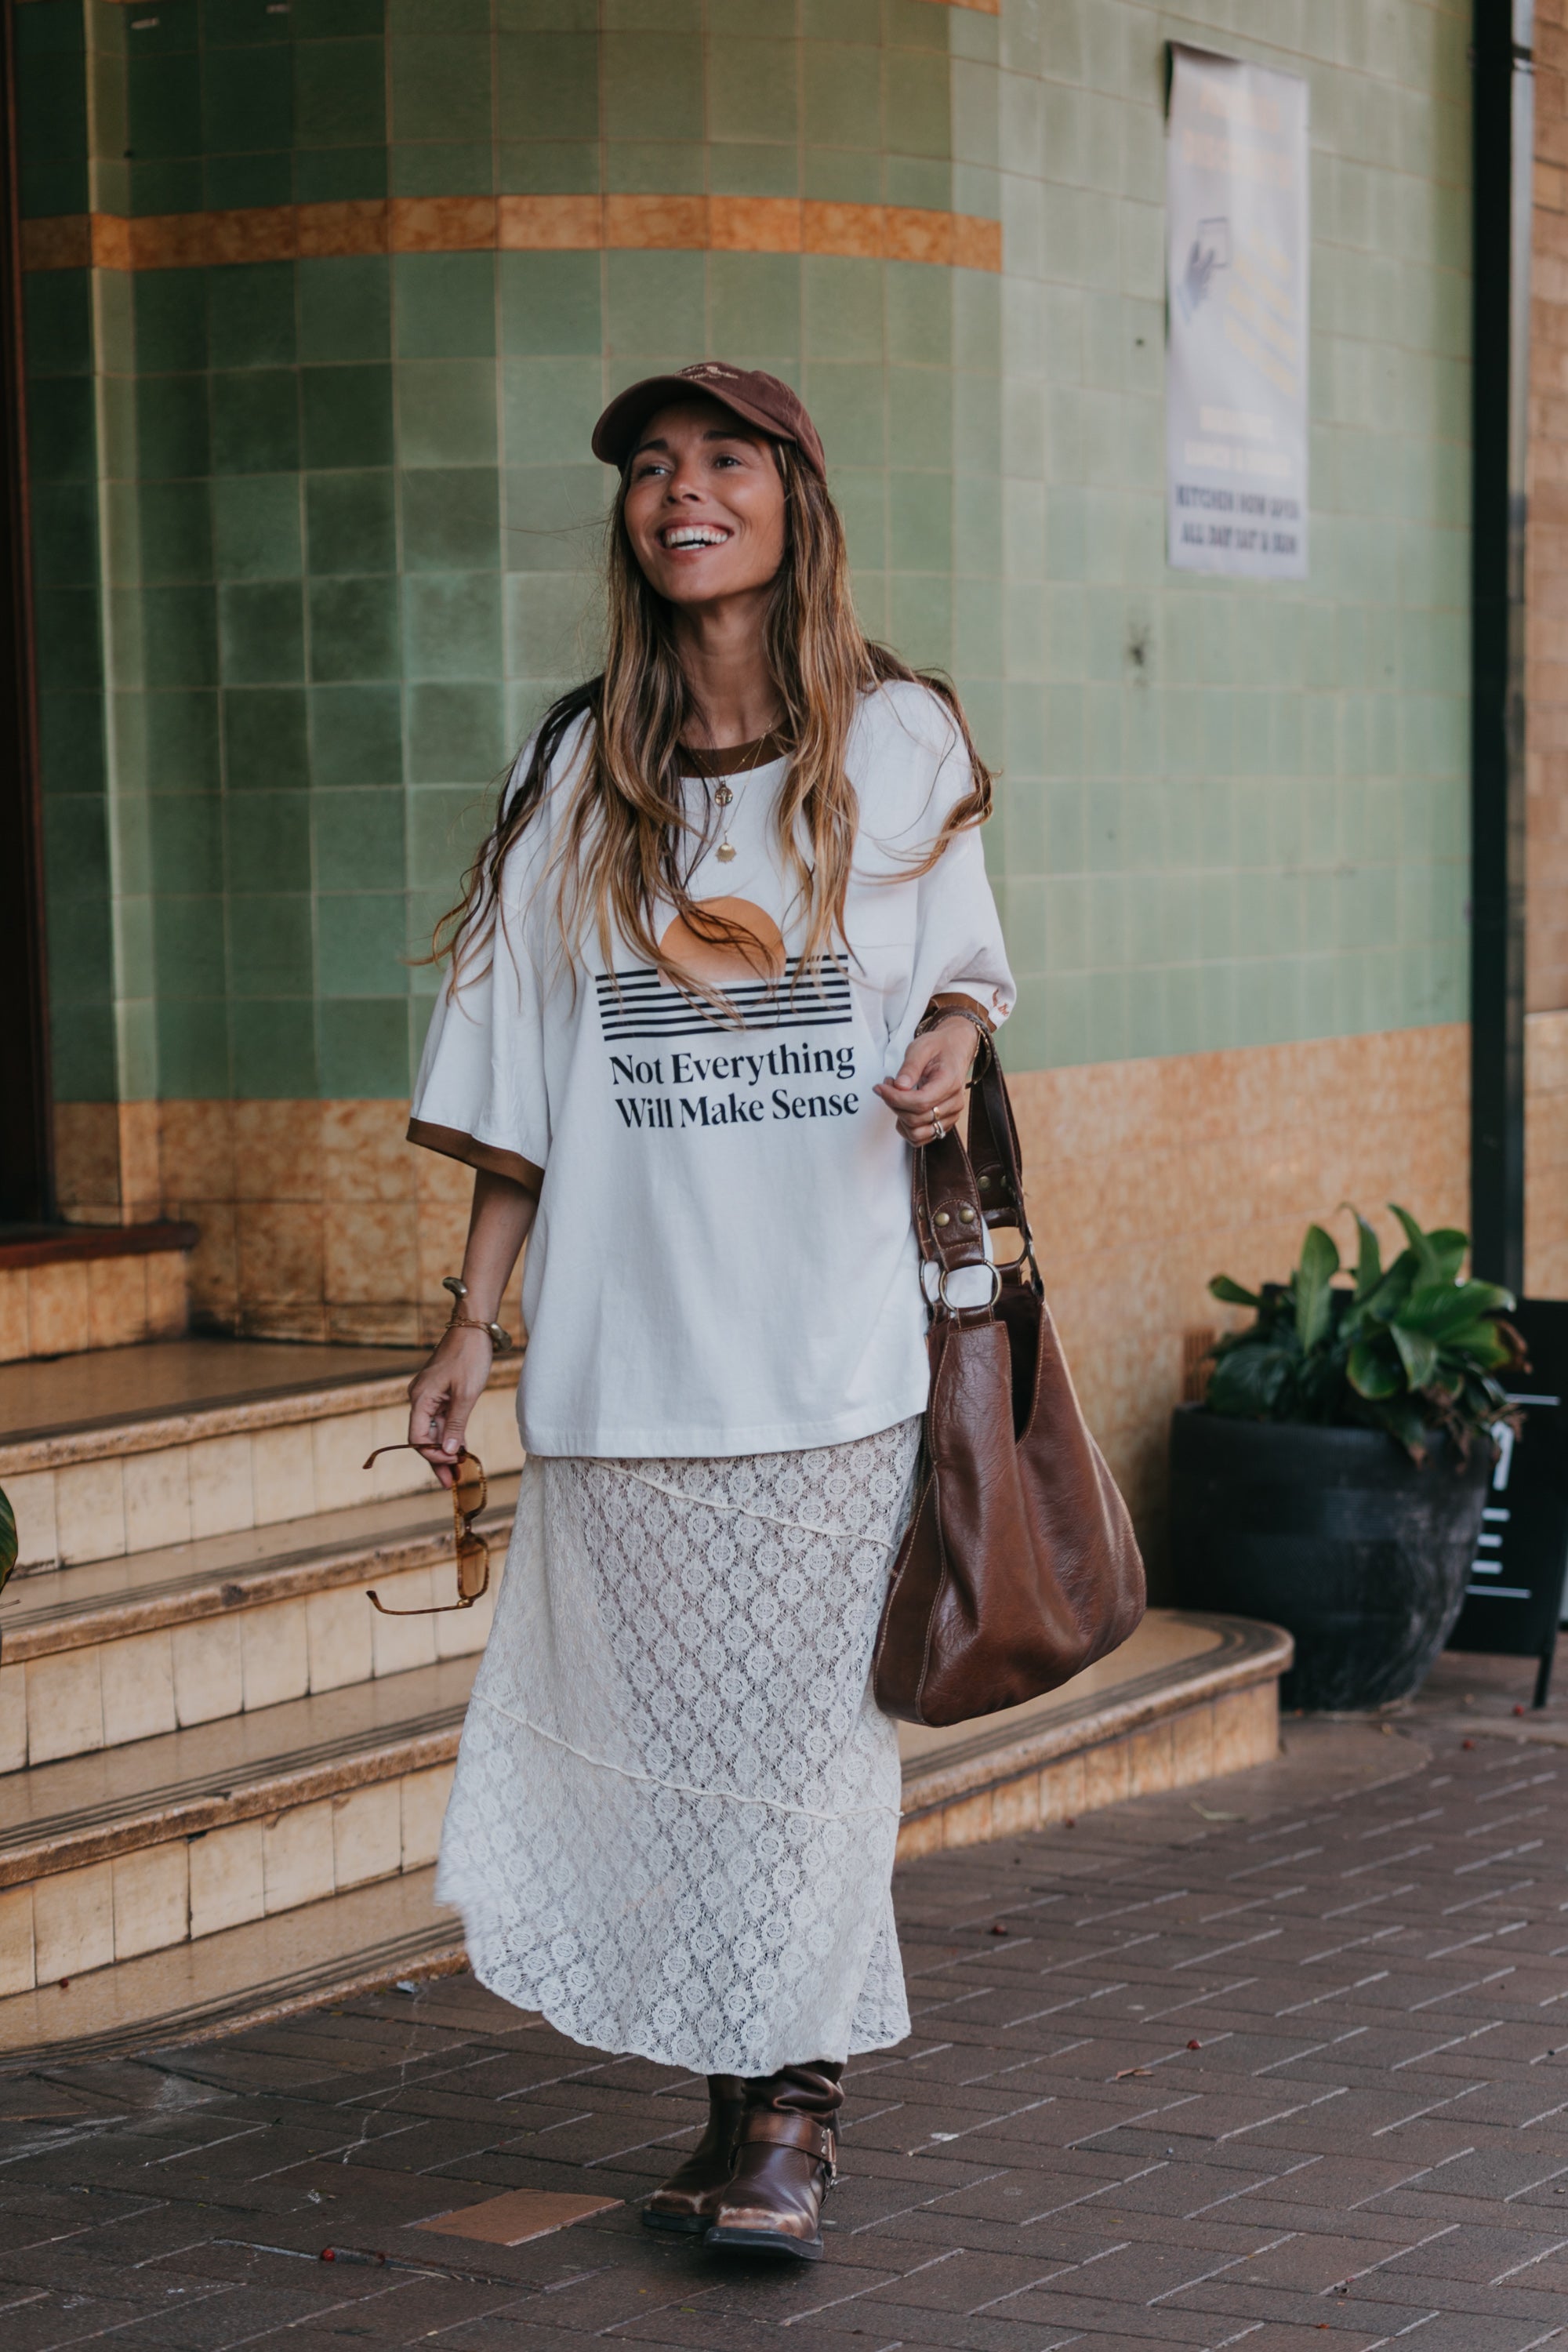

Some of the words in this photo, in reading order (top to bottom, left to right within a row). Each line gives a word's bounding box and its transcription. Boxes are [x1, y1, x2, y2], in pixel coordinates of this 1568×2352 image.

[609, 1054, 665, 1085] Not
[671, 1042, 855, 1087] Everything
[615, 1098, 674, 1128] Will
[679, 1092, 764, 1128] Make
[771, 1088, 859, 1120] Sense
